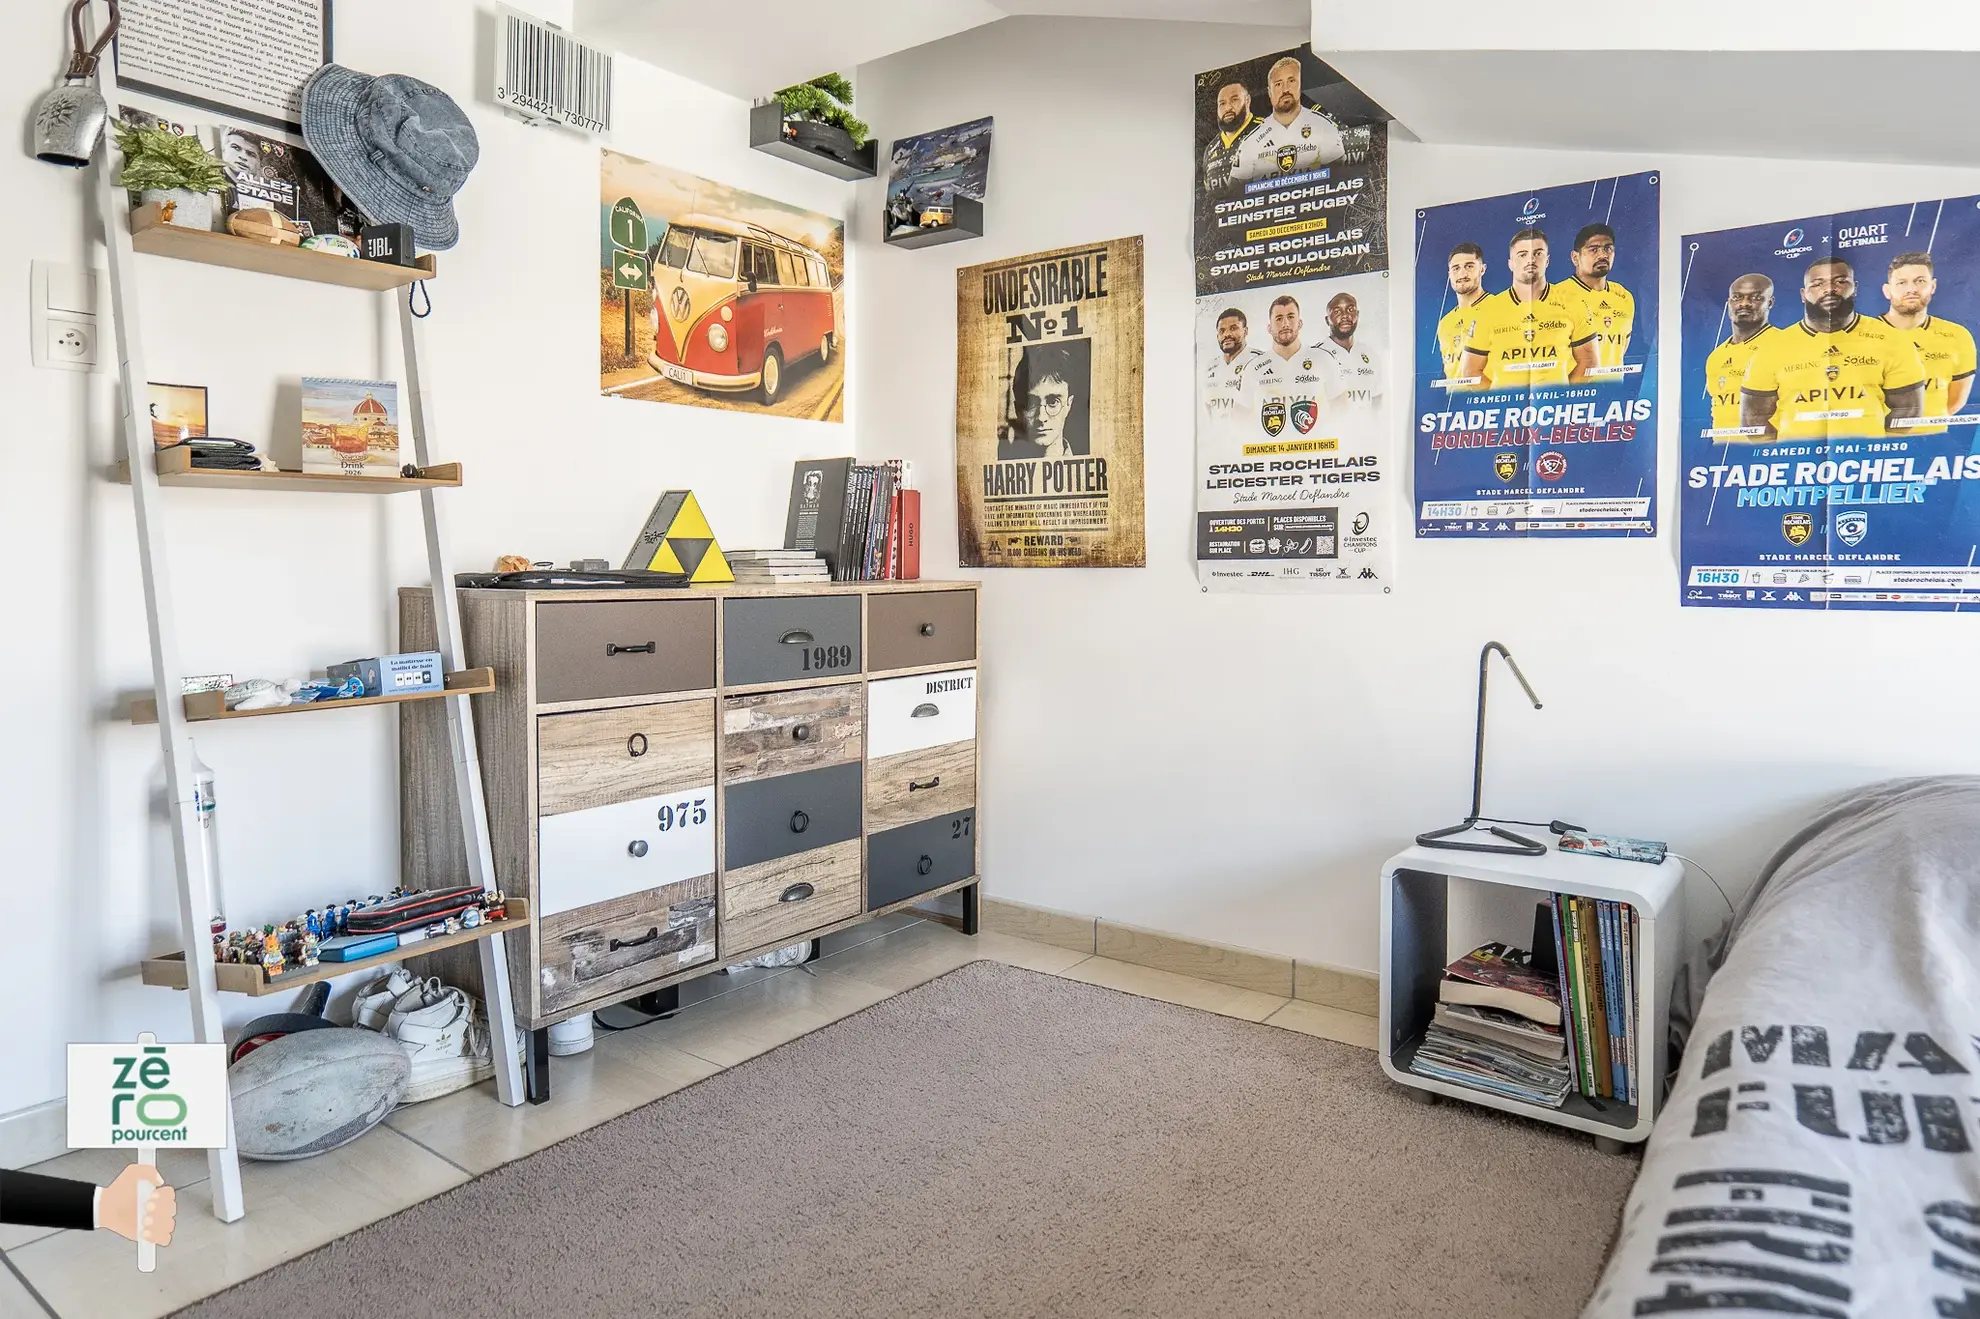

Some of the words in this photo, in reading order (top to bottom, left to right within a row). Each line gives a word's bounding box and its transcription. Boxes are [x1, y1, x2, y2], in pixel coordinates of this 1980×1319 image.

[306, 21, 318, 30] dire
[497, 87, 505, 99] 3
[512, 92, 554, 117] 294421
[564, 110, 604, 133] 730777
[236, 171, 293, 192] ALLEZ
[1248, 181, 1273, 191] DIMANCHE
[236, 184, 293, 205] STADE
[1215, 198, 1264, 214] STADE
[1268, 178, 1364, 204] ROCHELAIS
[1218, 204, 1295, 228] LEINSTER
[1300, 194, 1359, 213] RUGBY
[1516, 213, 1546, 222] CHAMPIONS
[628, 219, 633, 243] 1
[1249, 231, 1269, 239] SAMEDI
[1269, 228, 1276, 236] 30
[1838, 223, 1888, 240] QUART
[368, 237, 392, 258] JBL
[1215, 245, 1264, 261] STADE
[1268, 228, 1363, 252] ROCHELAIS
[1774, 246, 1812, 256] CHAMPIONS
[1839, 240, 1851, 248] DE
[1853, 236, 1888, 247] FINALE
[1210, 259, 1259, 276] STADE
[1264, 242, 1370, 268] TOULOUSAIN
[1246, 272, 1264, 283] Stade
[1266, 266, 1292, 279] Marcel
[1293, 263, 1331, 276] Deflandre
[983, 254, 1108, 315] UNDESIRABLE
[1501, 346, 1558, 361] APIVIA
[1473, 394, 1511, 404] SAMEDI
[1514, 393, 1525, 401] 16
[1420, 408, 1500, 433] STADE
[1504, 399, 1651, 428] ROCHELAIS
[1431, 421, 1637, 450] BORDEAUX-BÈGLES
[1246, 444, 1277, 454] DIMANCHE
[1278, 444, 1284, 452] 14
[1286, 442, 1313, 452] JANVIER
[1318, 441, 1335, 450] 16H15
[1762, 447, 1810, 457] SAMEDI
[1815, 446, 1830, 455] 07
[1209, 462, 1265, 475] STADE
[1270, 456, 1378, 472] ROCHELAIS
[1688, 462, 1790, 489] STADE
[1794, 454, 1980, 484] ROCHELAIS
[983, 462, 1037, 497] HARRY
[1042, 458, 1108, 494] POTTER
[1206, 475, 1304, 489] LEICESTER
[1310, 471, 1381, 484] TIGERS
[1233, 492, 1257, 504] Stade
[1261, 490, 1298, 502] Marcel
[1300, 489, 1350, 503] Deflandre
[1476, 488, 1502, 496] STADE
[1736, 483, 1927, 508] MONTPELLIER
[1428, 507, 1462, 516] 14H30
[1024, 535, 1063, 546] REWARD
[1697, 573, 1740, 584] 16H30
[802, 645, 852, 671] 1989
[925, 676, 974, 695] DISTRICT
[657, 798, 707, 833] 975
[951, 816, 971, 840] 27
